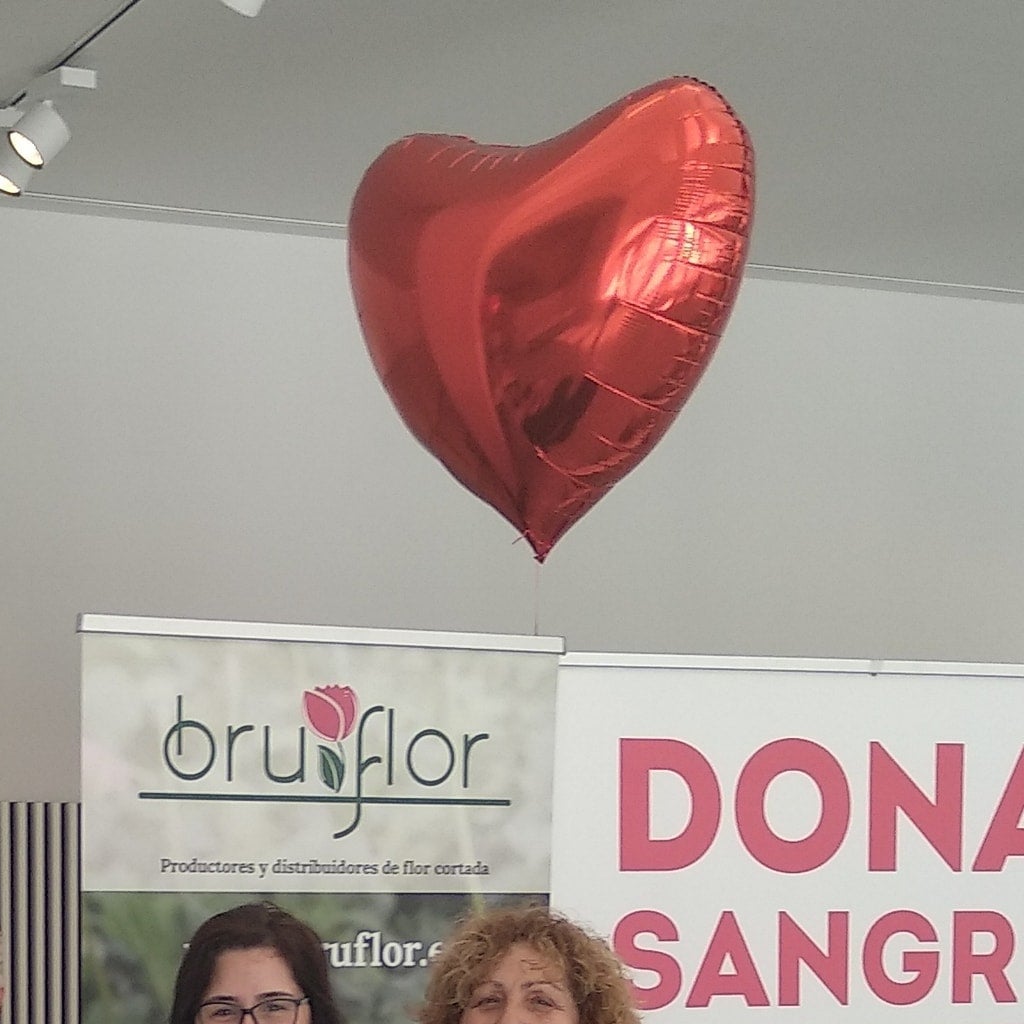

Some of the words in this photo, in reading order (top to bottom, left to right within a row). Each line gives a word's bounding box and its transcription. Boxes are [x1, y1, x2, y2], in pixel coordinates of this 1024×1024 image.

[163, 695, 490, 839] bruflor
[160, 858, 255, 874] Productores
[258, 863, 268, 878] y
[272, 858, 379, 875] distribuidores
[381, 860, 400, 876] de
[403, 860, 430, 876] flor
[434, 861, 490, 876] cortada
[612, 909, 1019, 1011] SANGR
